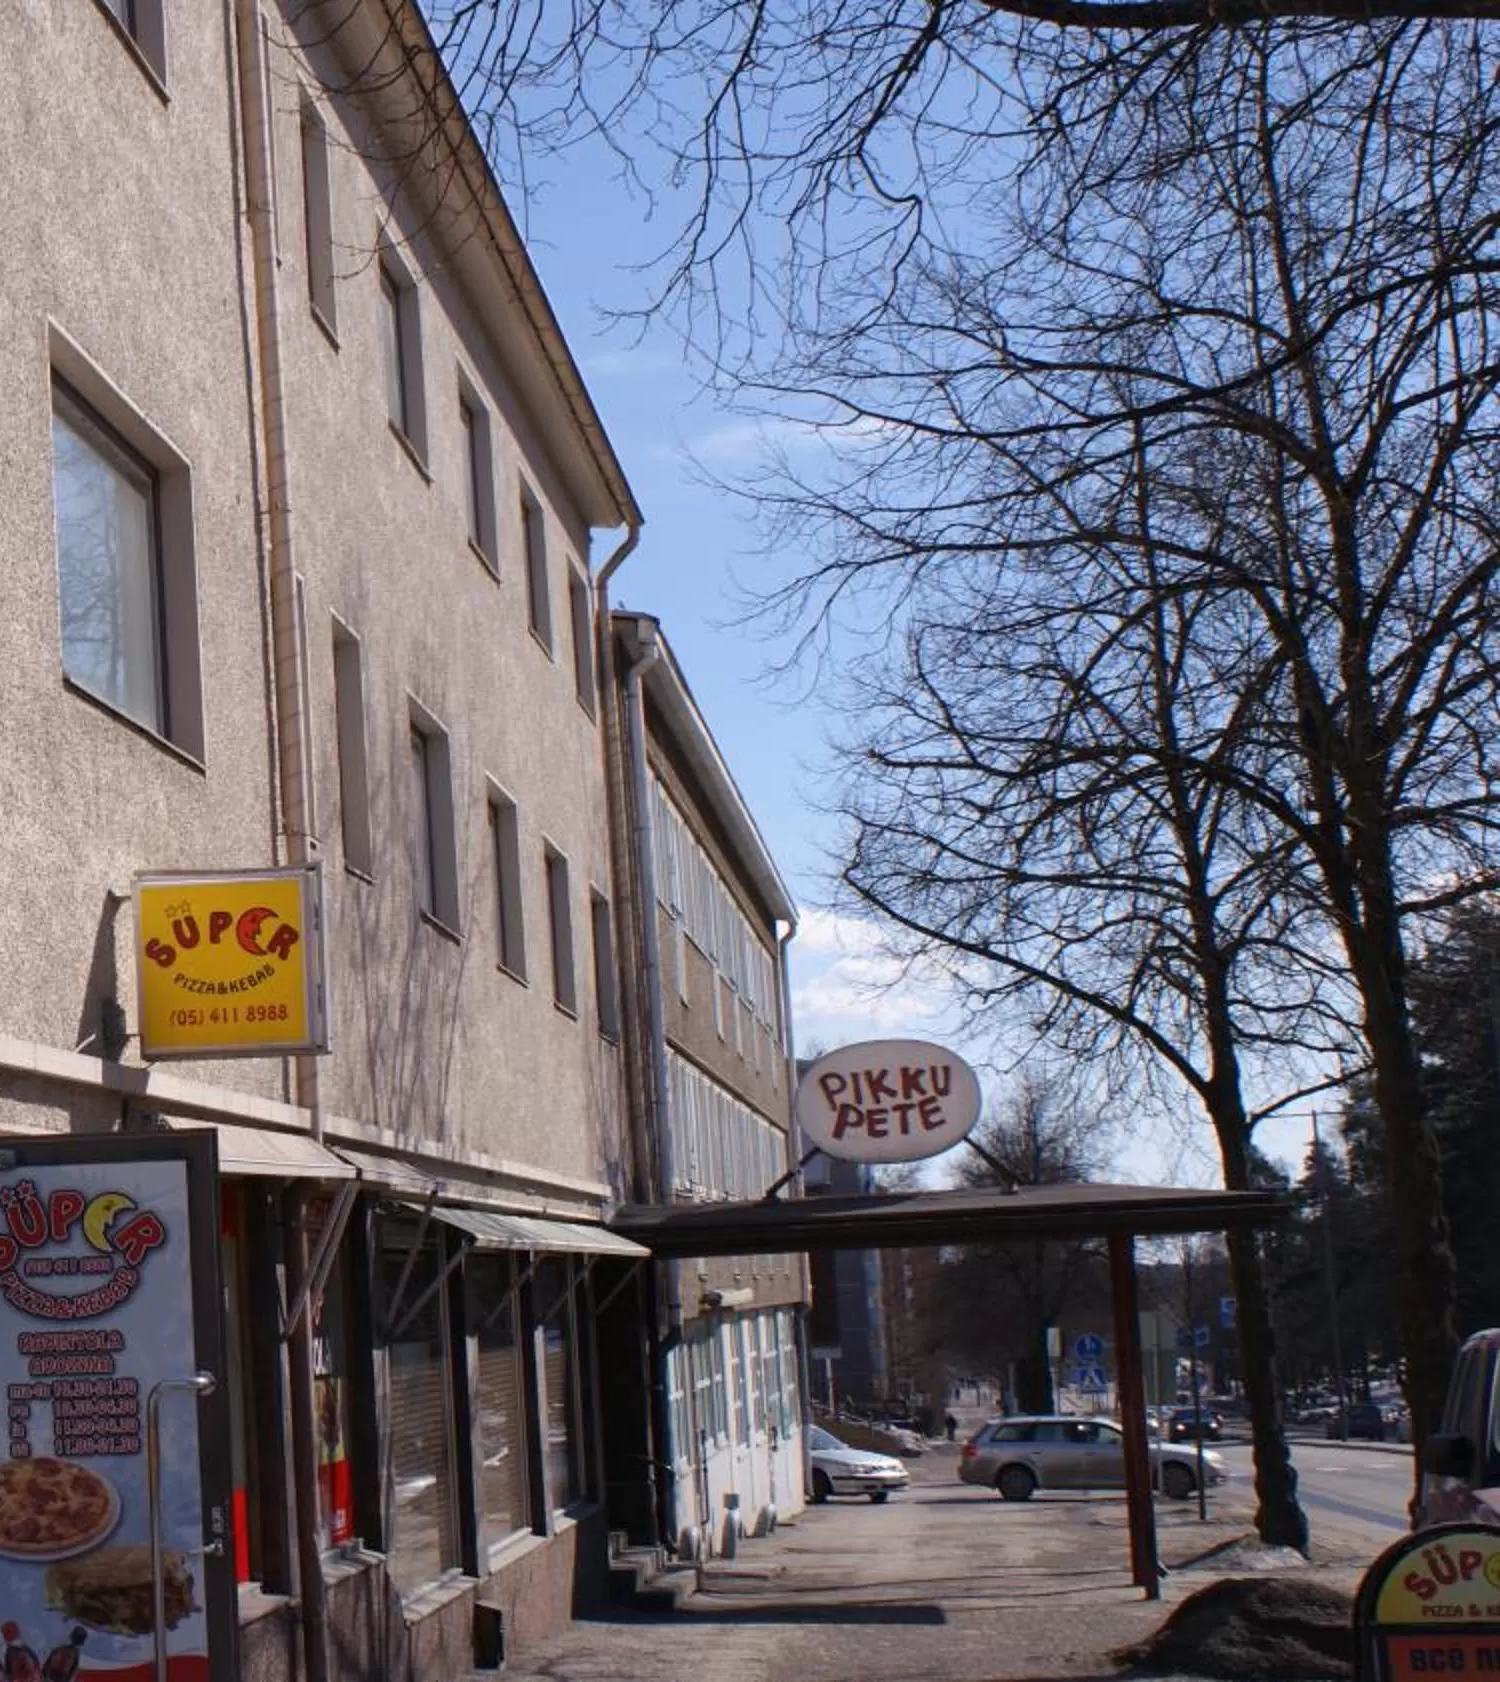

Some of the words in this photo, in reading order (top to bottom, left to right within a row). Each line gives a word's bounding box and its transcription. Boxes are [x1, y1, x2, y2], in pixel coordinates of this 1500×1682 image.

[169, 1006, 203, 1026] (05)
[210, 1005, 239, 1024] 411
[246, 1003, 288, 1023] 8988
[818, 1065, 952, 1112] PIKKU
[831, 1096, 947, 1139] PETE
[1422, 1604, 1463, 1617] PIZZA
